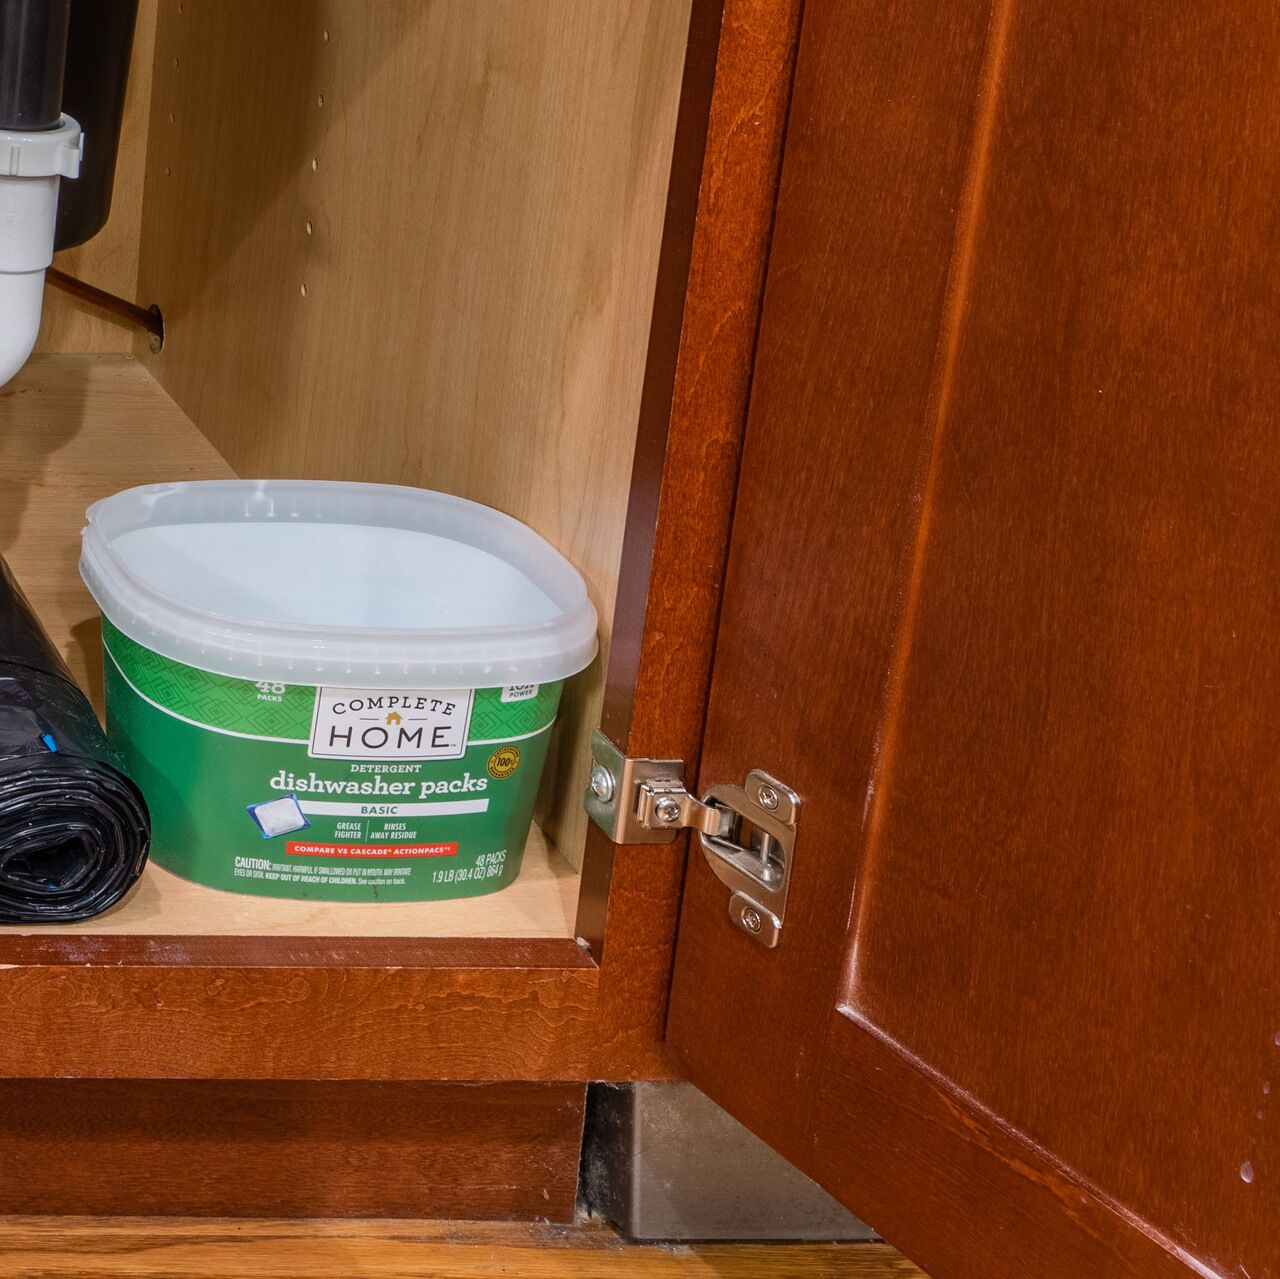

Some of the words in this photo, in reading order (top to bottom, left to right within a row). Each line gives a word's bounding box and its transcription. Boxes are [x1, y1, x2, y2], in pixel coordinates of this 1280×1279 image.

[257, 694, 282, 702] PACKS
[509, 689, 533, 698] POWER
[332, 696, 456, 716] COMPLETE
[351, 764, 422, 774] DETERGENT
[269, 770, 416, 796] dishwasher
[419, 772, 488, 799] packs
[360, 806, 399, 815] BASIC
[336, 822, 361, 831] GREASE
[384, 822, 406, 831] RINSES
[334, 830, 362, 839] FIGHTER
[370, 831, 389, 839] AWAY
[390, 831, 417, 839] RESIDUE
[294, 845, 335, 854] COMPARE
[475, 854, 486, 867] 48
[486, 849, 507, 865] PACKS
[234, 856, 272, 871] CAUTION:
[265, 872, 280, 880] KEEP
[280, 873, 292, 881] OUT
[292, 874, 300, 882] OF
[301, 875, 320, 883] REACH
[320, 876, 328, 884] OF
[432, 870, 444, 883] 1.9
[443, 869, 455, 883] LB
[454, 868, 473, 884] (30.4
[473, 867, 486, 880] OZ)
[486, 864, 498, 877] 864
